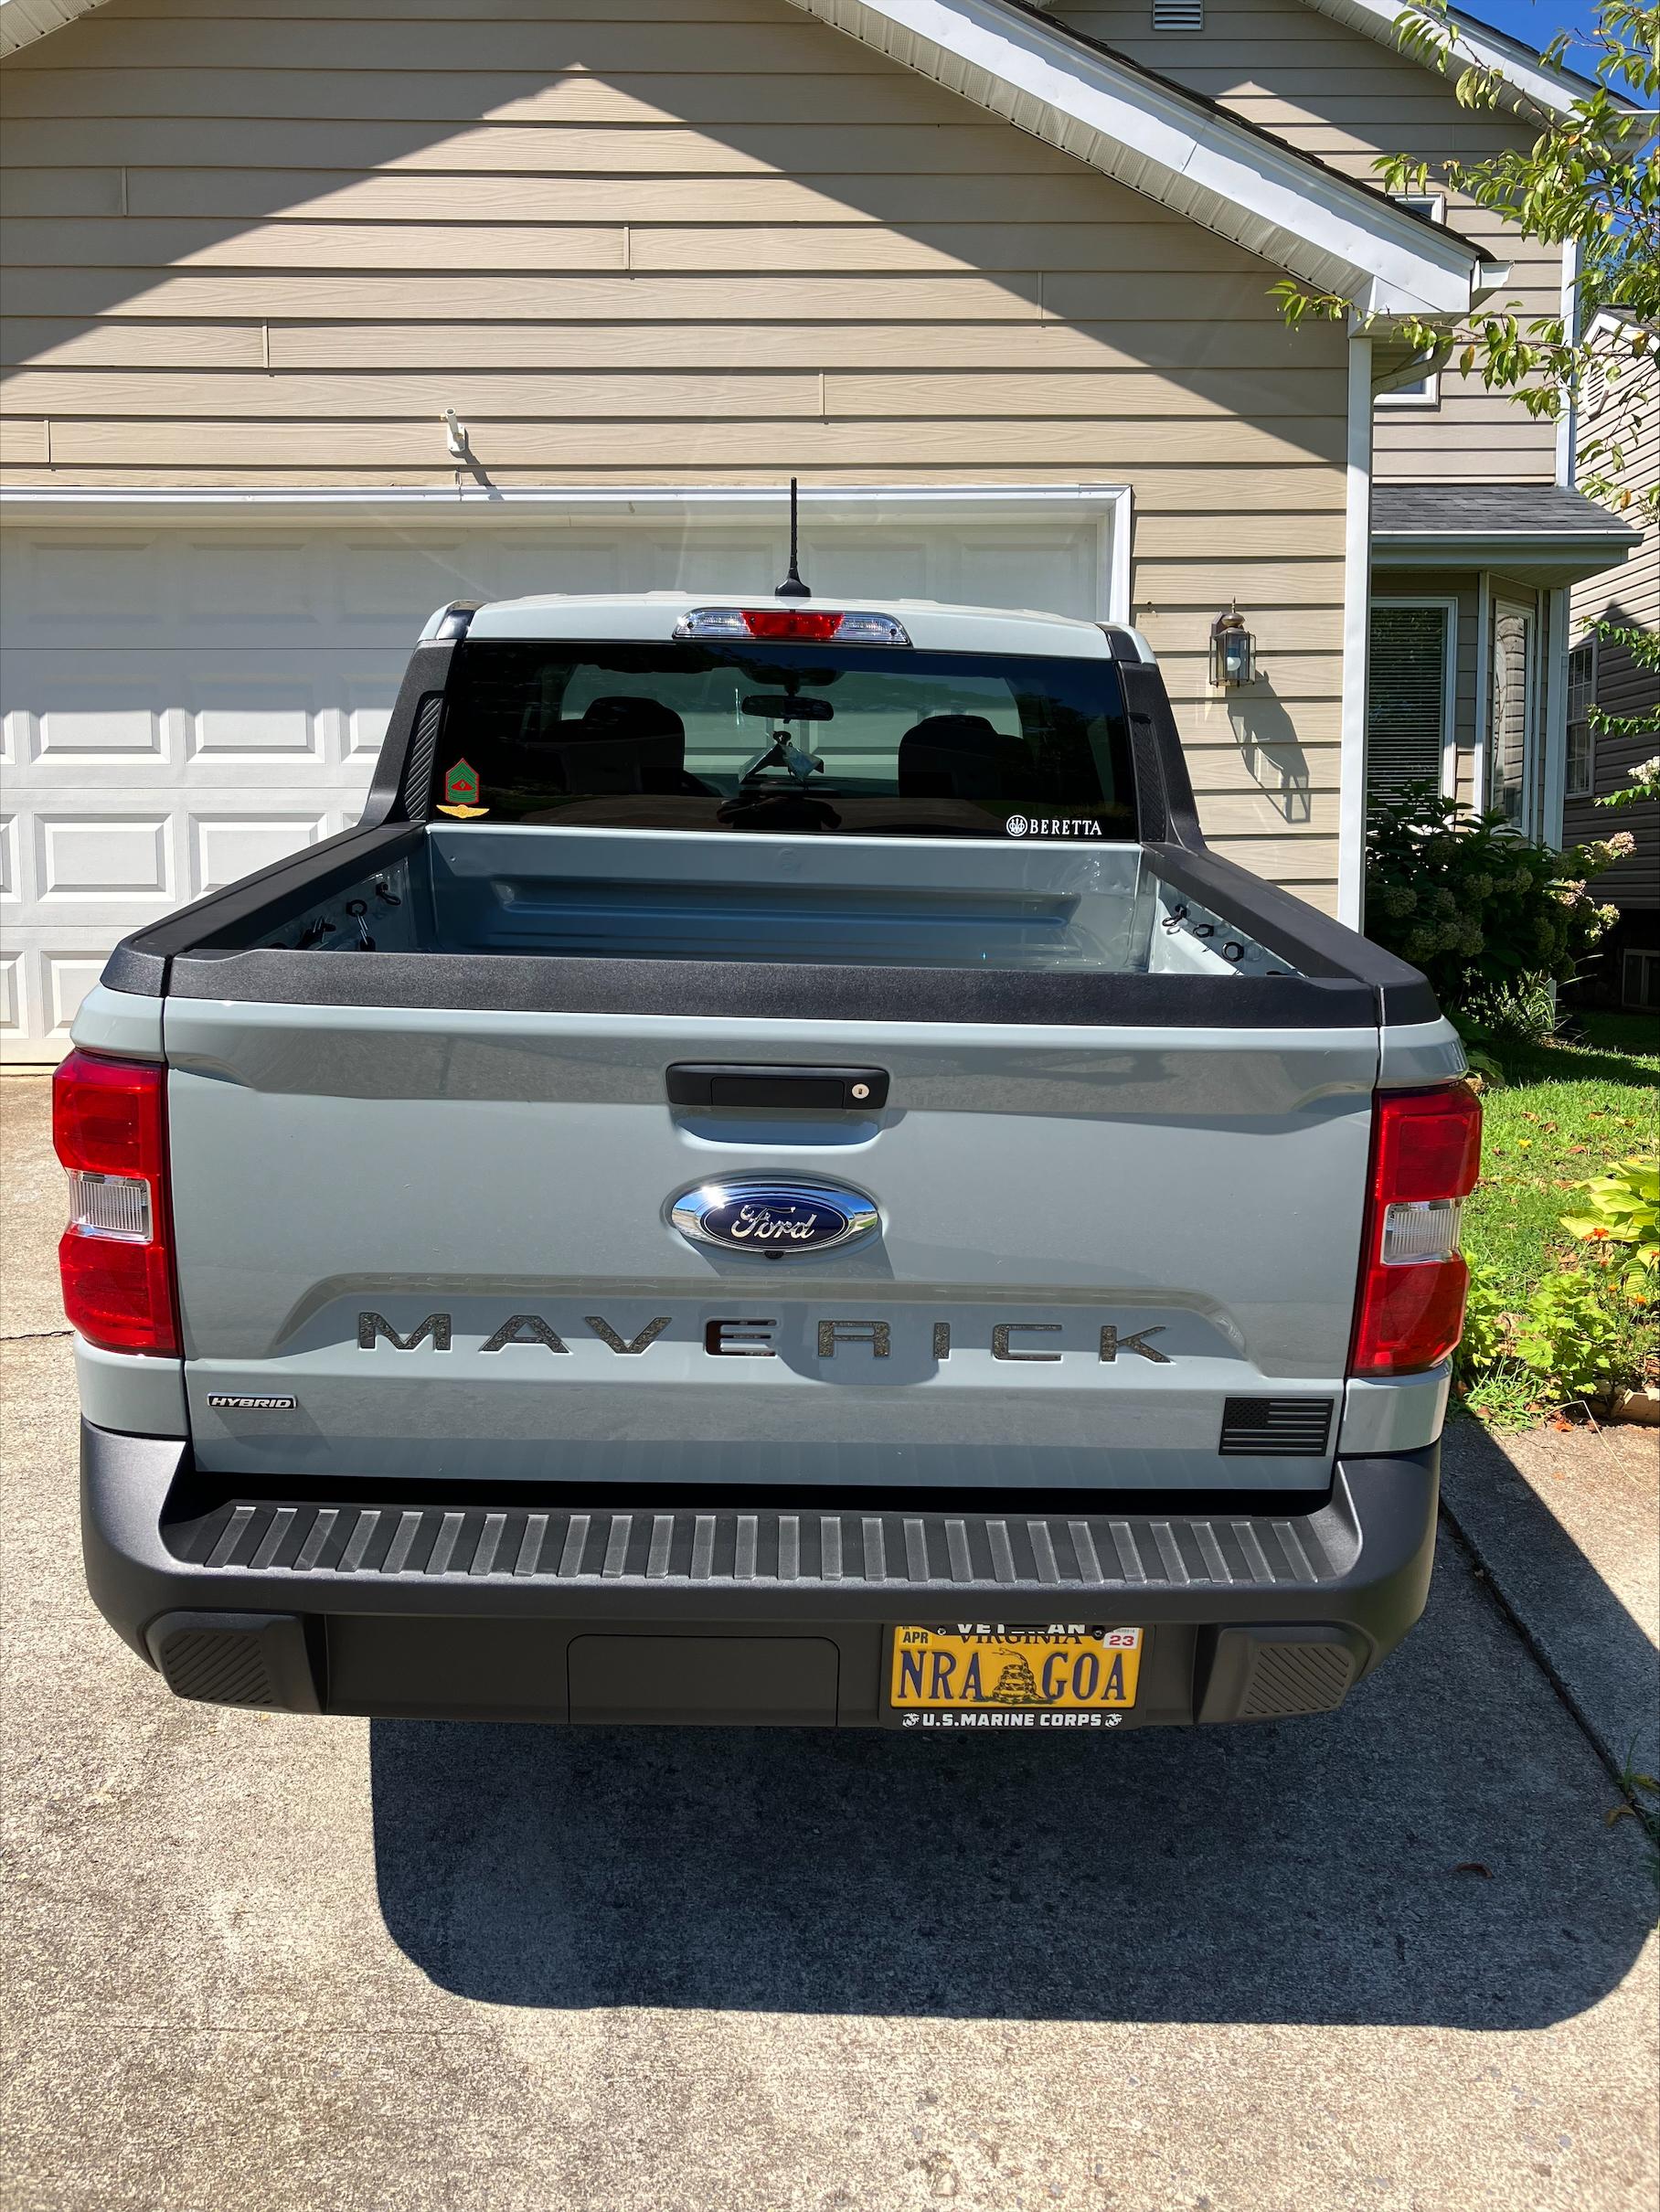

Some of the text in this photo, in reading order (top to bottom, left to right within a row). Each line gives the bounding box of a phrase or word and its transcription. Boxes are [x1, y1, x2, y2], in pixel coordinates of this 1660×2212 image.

[1029, 819, 1102, 835] BERETTA
[730, 1204, 818, 1239] Ford
[357, 1311, 1173, 1364] MAVERICK
[211, 1397, 292, 1409] HYBRID
[902, 1631, 929, 1644] APR
[1109, 1634, 1134, 1646] 23
[897, 1650, 1127, 1700] NRA GOA
[1039, 1713, 1102, 1727] CORPS
